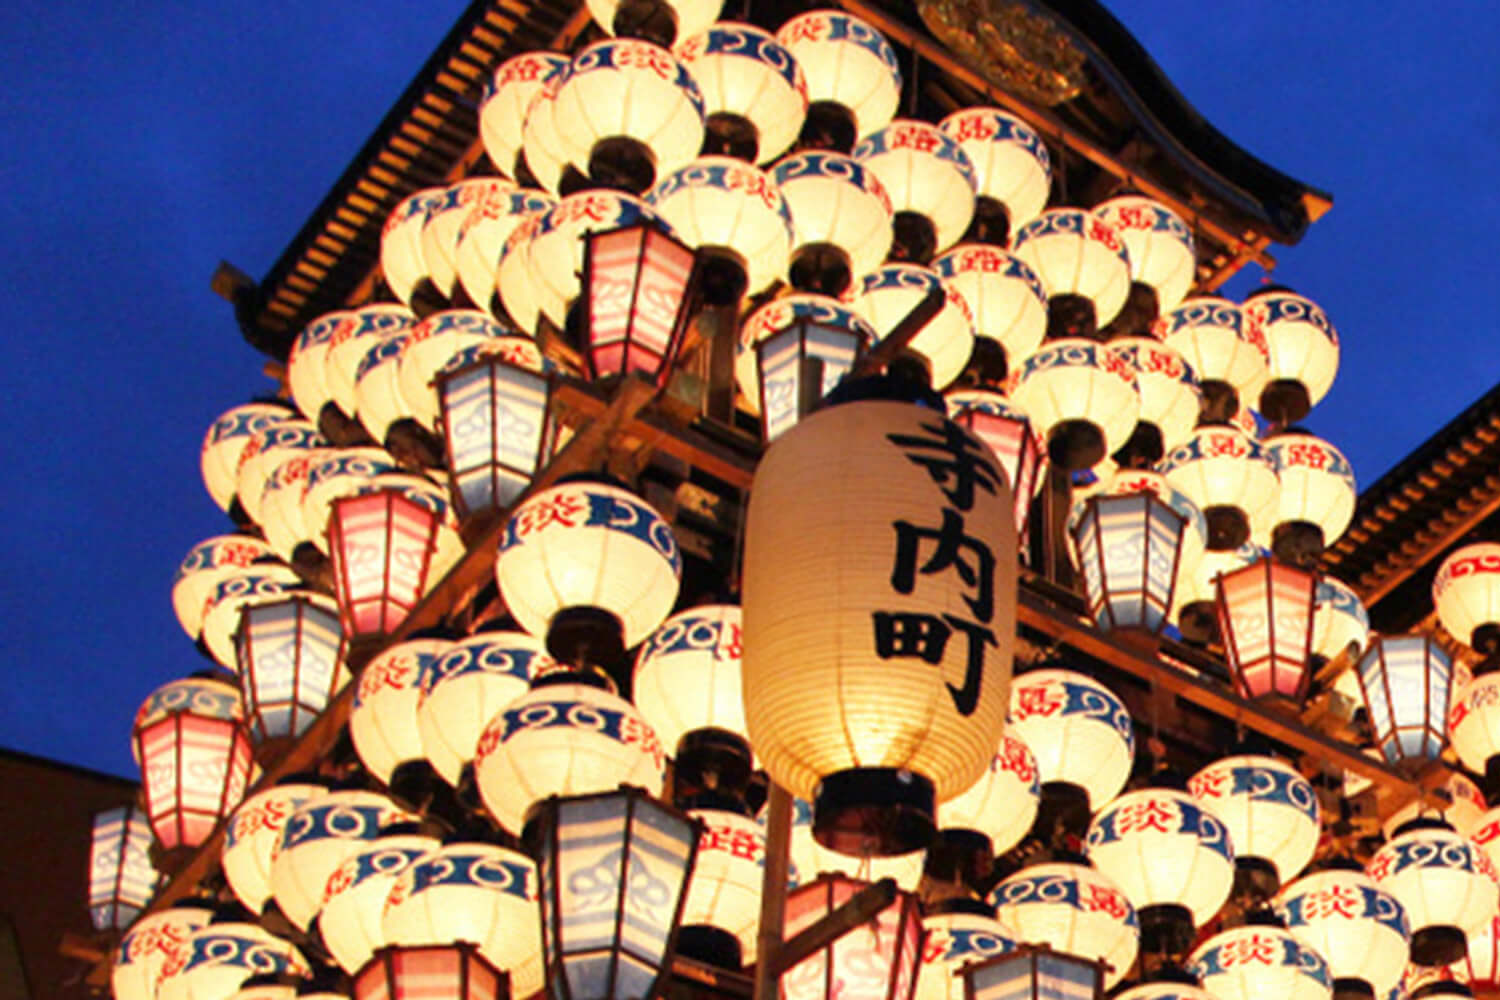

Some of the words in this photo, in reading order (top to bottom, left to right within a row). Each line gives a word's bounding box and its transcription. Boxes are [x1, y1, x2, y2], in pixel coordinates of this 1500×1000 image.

[520, 493, 585, 536] 淡
[872, 416, 999, 717] 寺内町
[1012, 680, 1062, 720] 島
[1120, 800, 1174, 834] 淡
[1306, 885, 1357, 921] 淡
[1220, 935, 1274, 967] 淡
